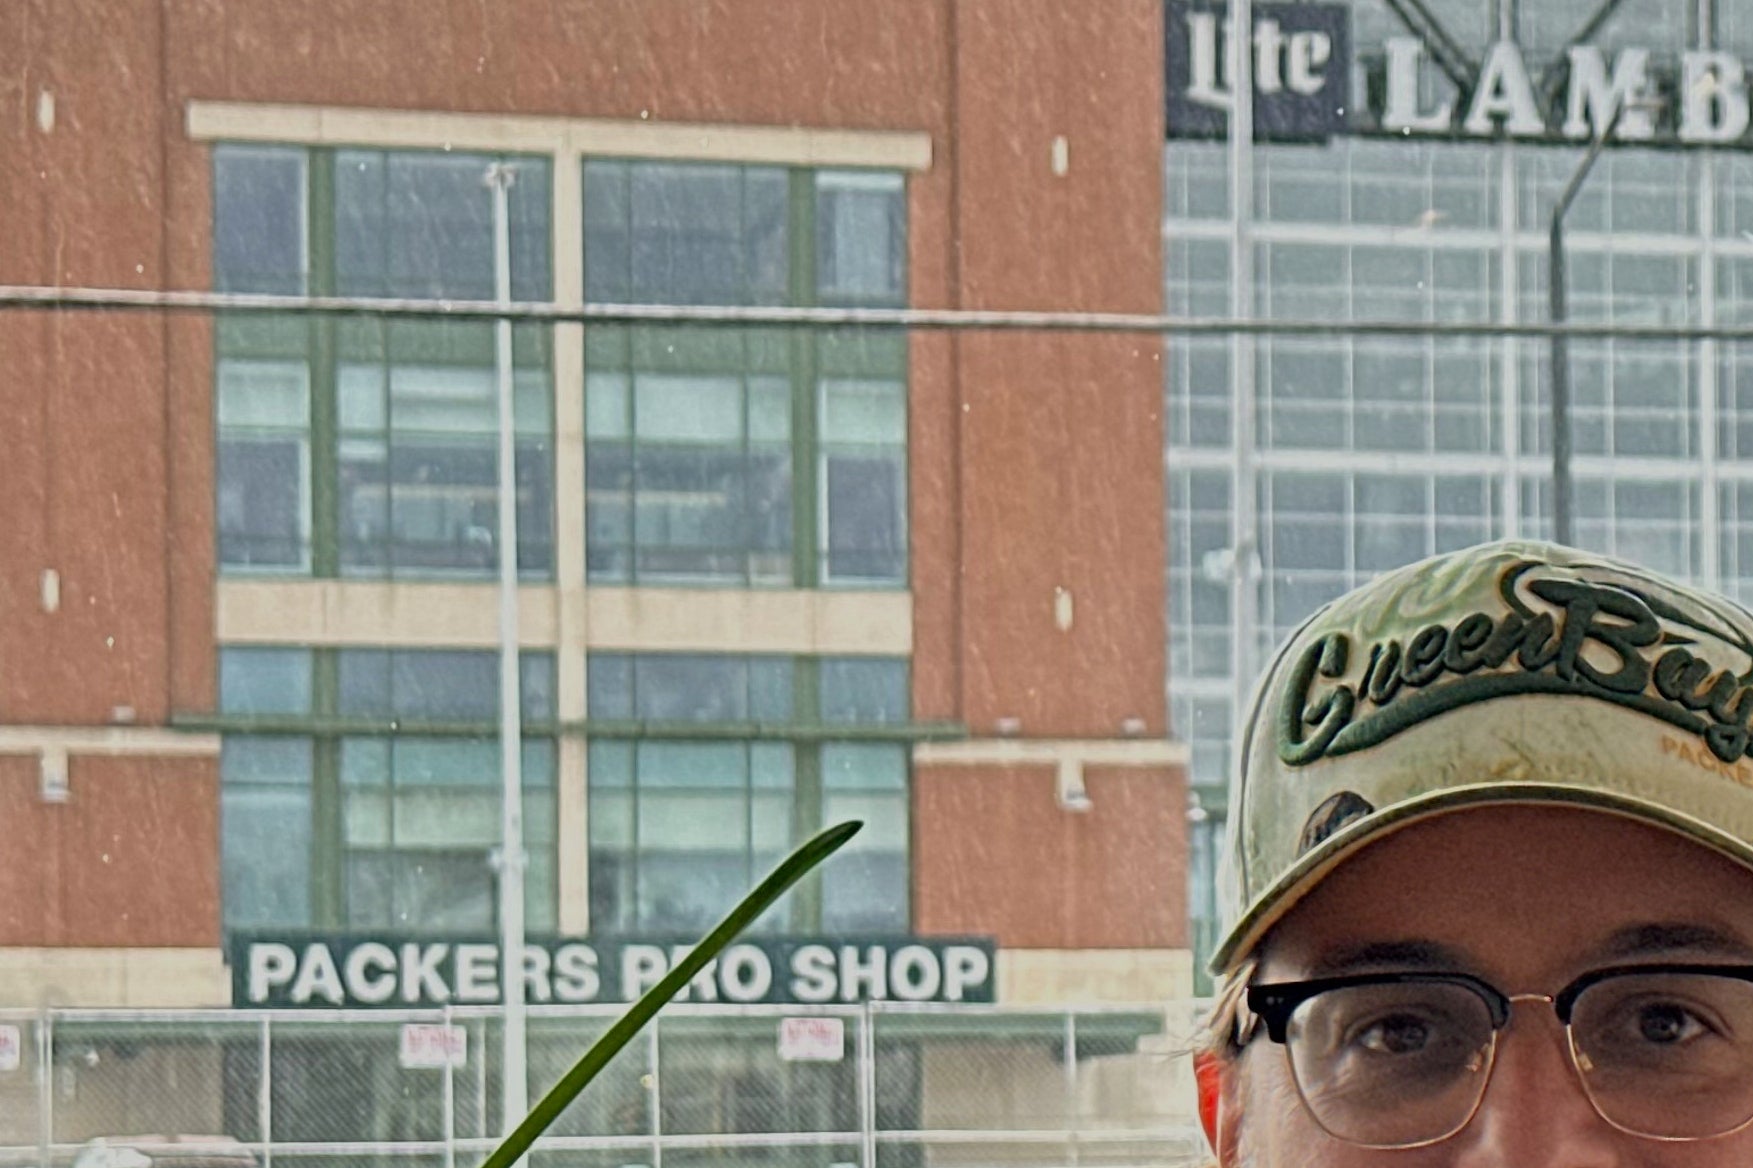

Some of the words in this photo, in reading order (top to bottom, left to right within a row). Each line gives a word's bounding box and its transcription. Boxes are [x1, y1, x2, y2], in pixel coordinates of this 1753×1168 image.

[1185, 10, 1332, 106] Lite
[1277, 612, 1556, 766] Green
[249, 942, 600, 1004] PACKERS
[790, 945, 989, 1001] SHOP
